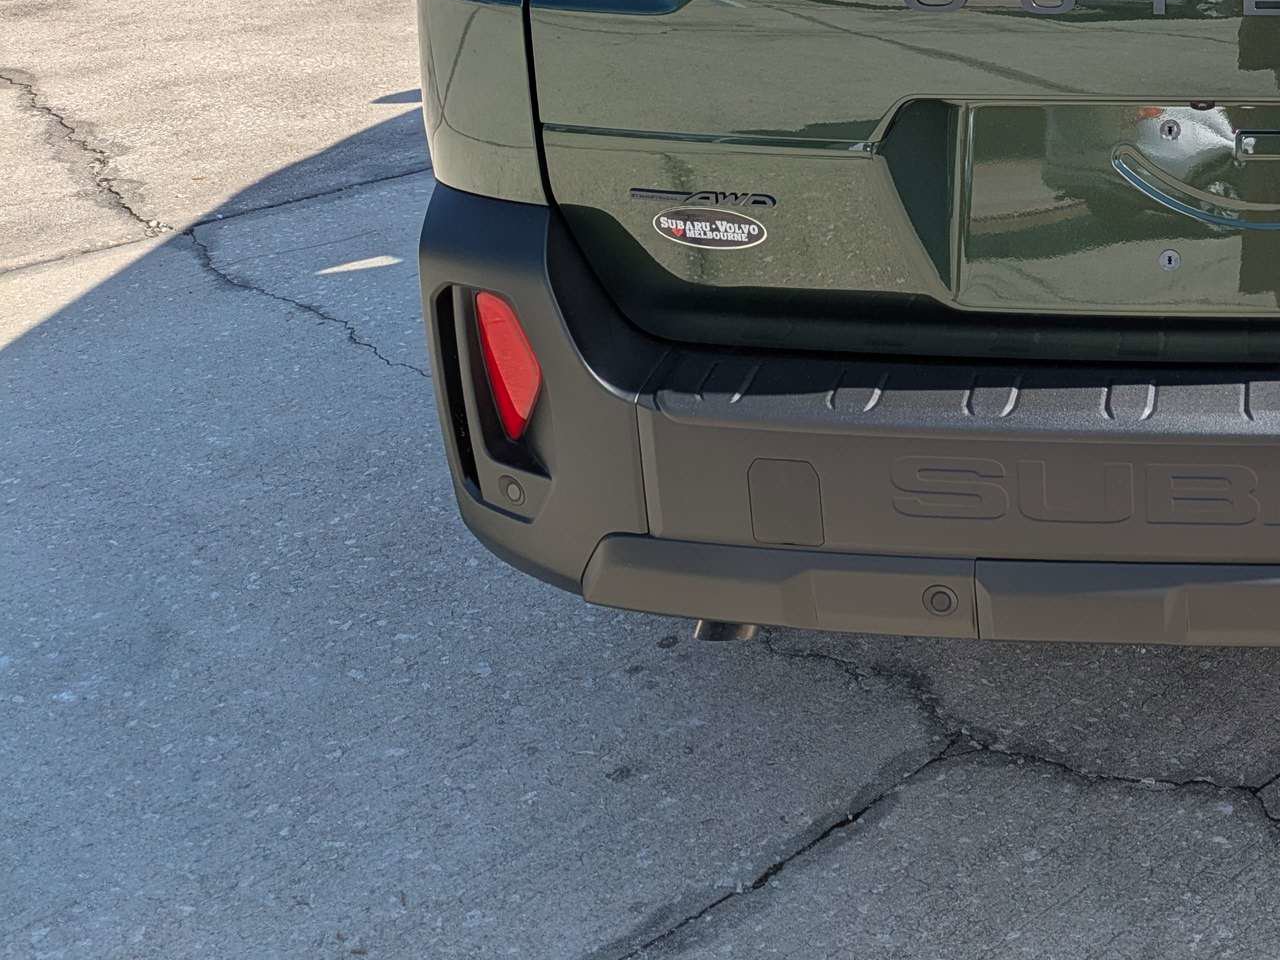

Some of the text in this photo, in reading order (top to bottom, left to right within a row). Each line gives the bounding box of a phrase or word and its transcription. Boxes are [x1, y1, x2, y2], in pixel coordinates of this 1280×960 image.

[684, 190, 777, 208] AWD
[659, 216, 759, 235] SUBARU VOLVO
[685, 228, 749, 242] MELBOURNE
